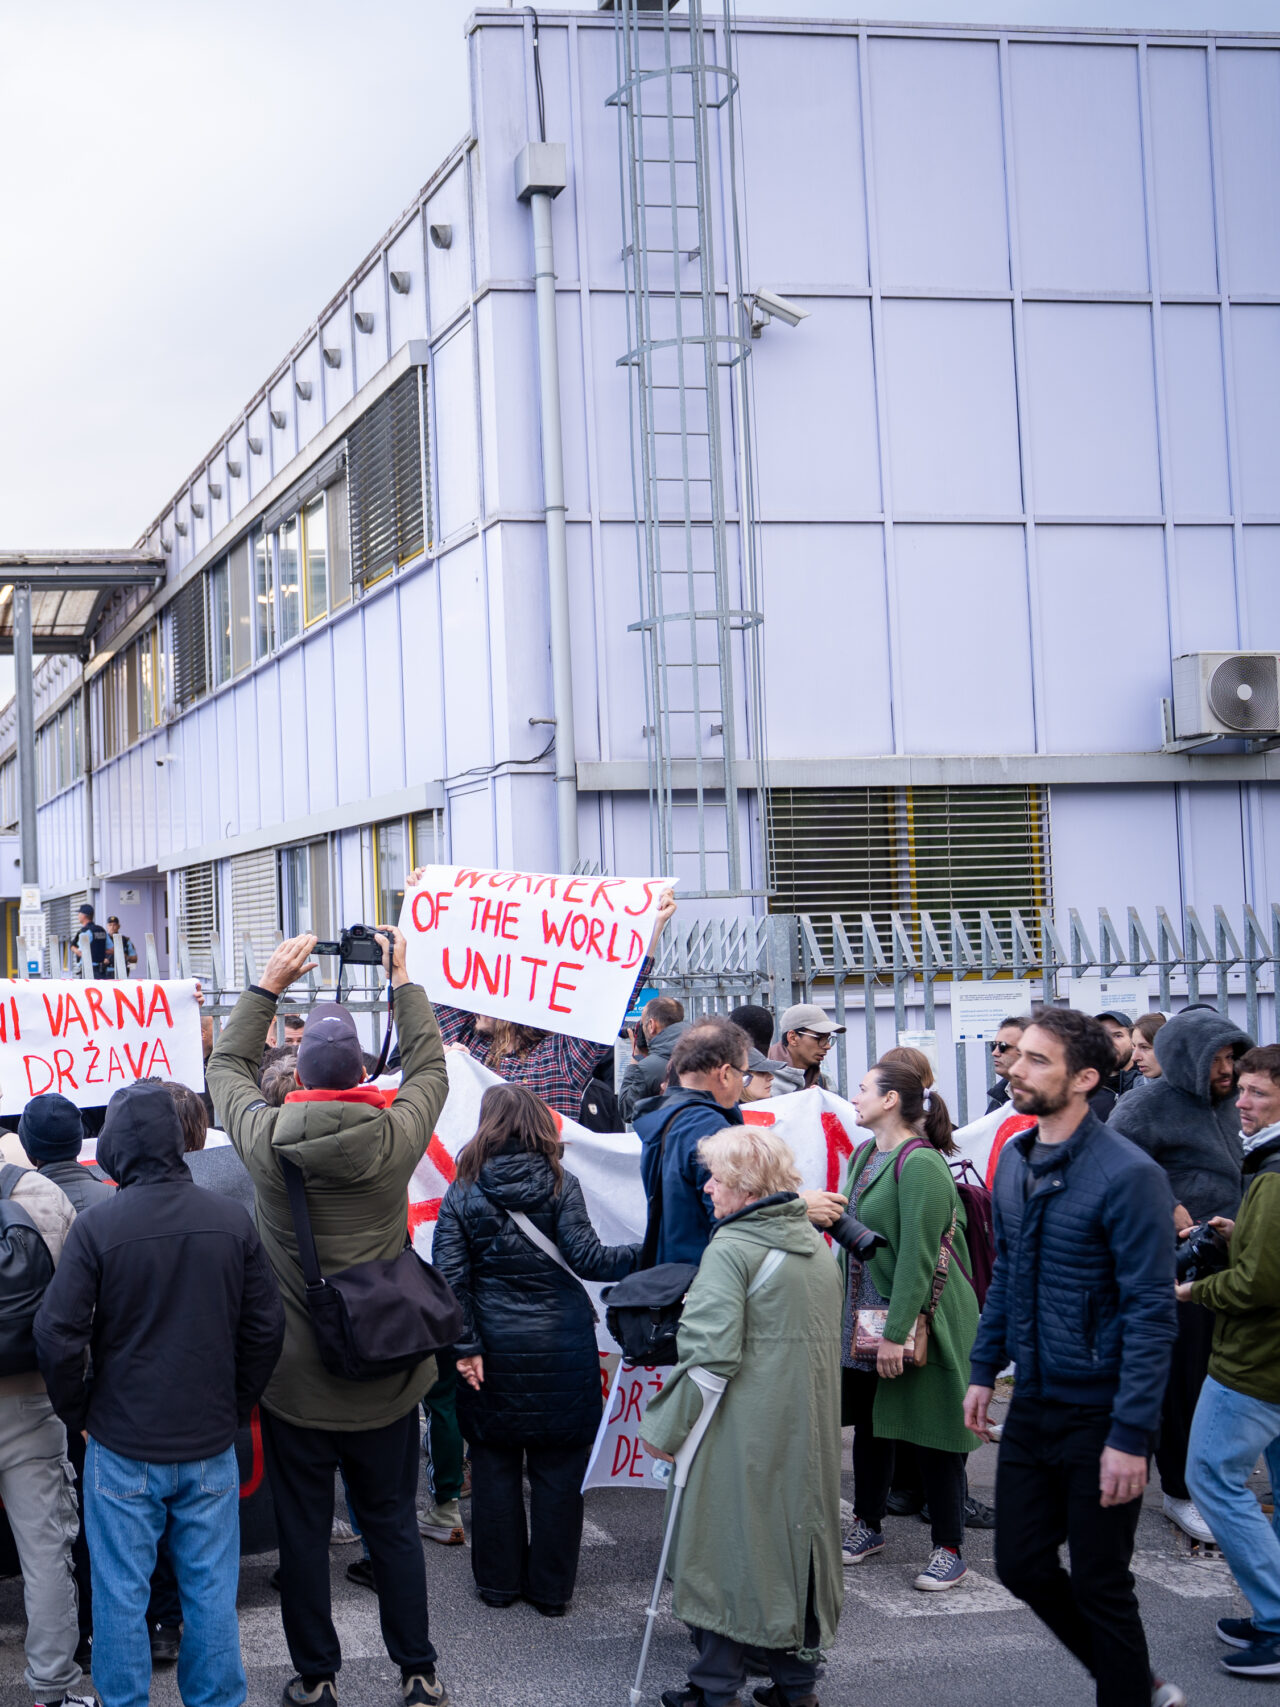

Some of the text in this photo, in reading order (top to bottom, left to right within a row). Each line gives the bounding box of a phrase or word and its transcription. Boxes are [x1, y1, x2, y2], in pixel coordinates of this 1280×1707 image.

[411, 891, 644, 969] OF THE WORLD
[42, 984, 174, 1038] VARNA
[442, 947, 585, 1014] UNITE
[23, 1037, 172, 1097] DRŽAVA
